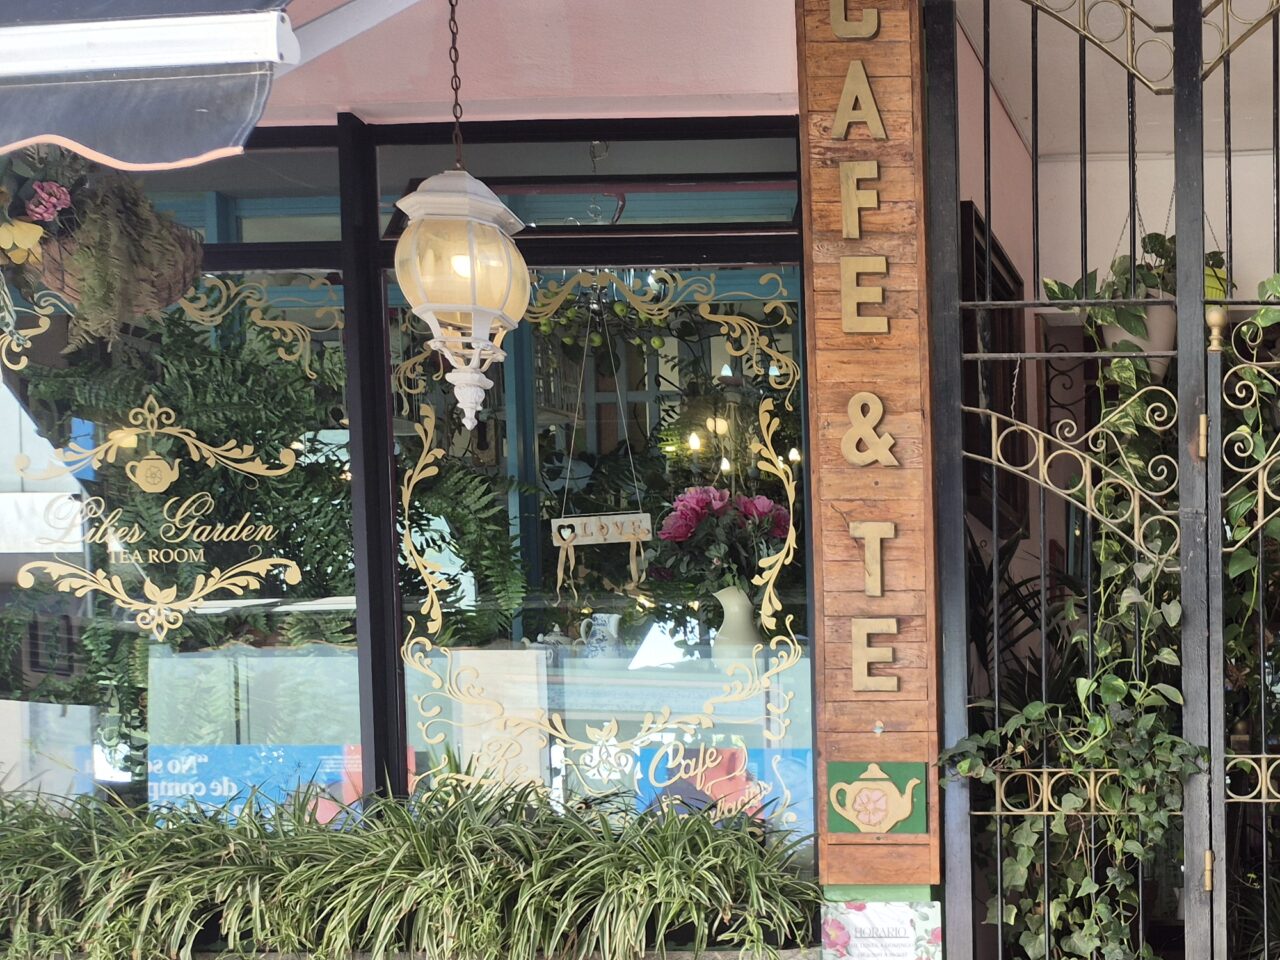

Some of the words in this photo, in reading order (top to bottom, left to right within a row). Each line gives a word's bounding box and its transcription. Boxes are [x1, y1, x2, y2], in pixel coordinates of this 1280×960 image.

[841, 391, 899, 467] &
[160, 491, 279, 544] Garden
[109, 550, 145, 564] TEA
[148, 548, 206, 563] ROOM
[849, 521, 899, 692] TE
[649, 741, 722, 790] Cafe
[855, 927, 907, 937] HORARIO
